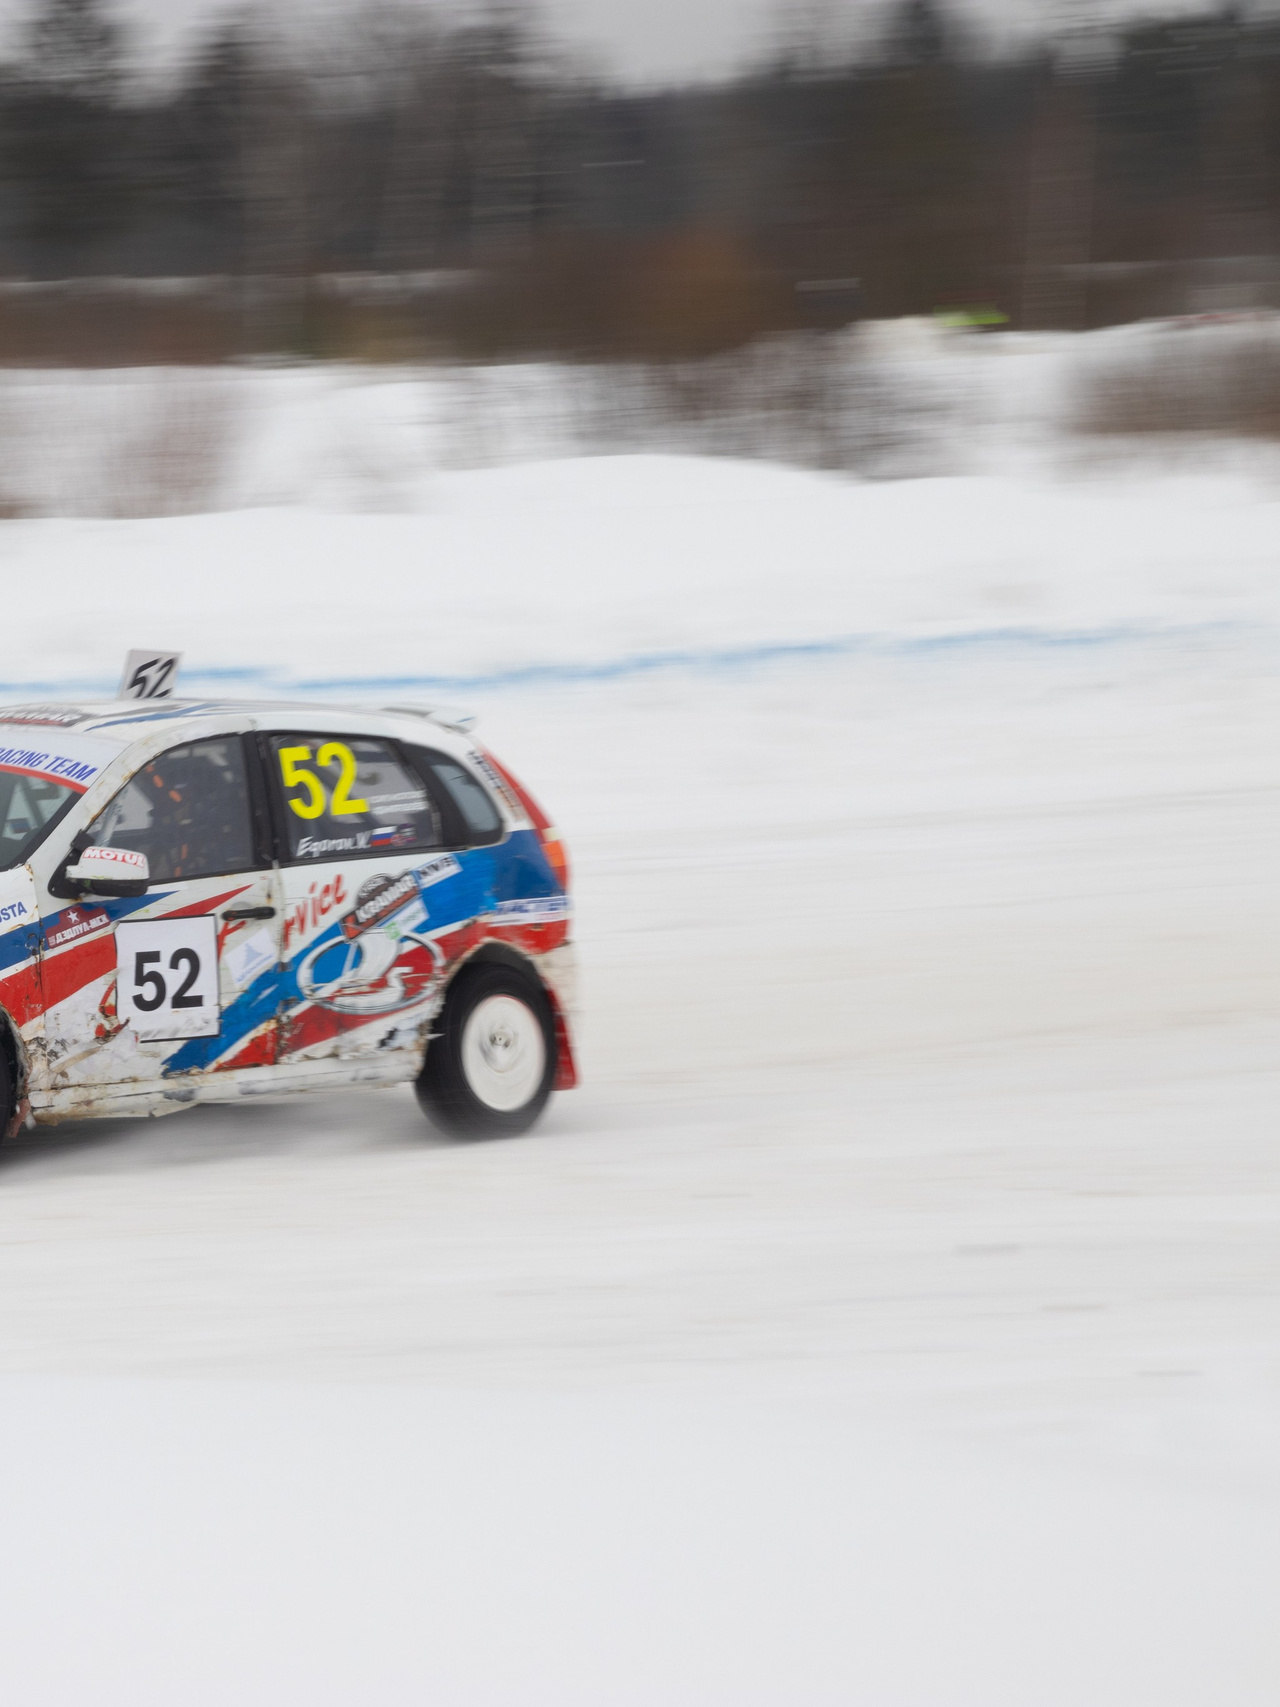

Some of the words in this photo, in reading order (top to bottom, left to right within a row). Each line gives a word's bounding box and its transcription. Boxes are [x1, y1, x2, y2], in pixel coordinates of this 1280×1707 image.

[126, 656, 178, 699] 52
[43, 755, 99, 782] TEAM
[278, 741, 370, 820] 52
[82, 847, 145, 868] MOTUL
[131, 947, 204, 1012] 52
